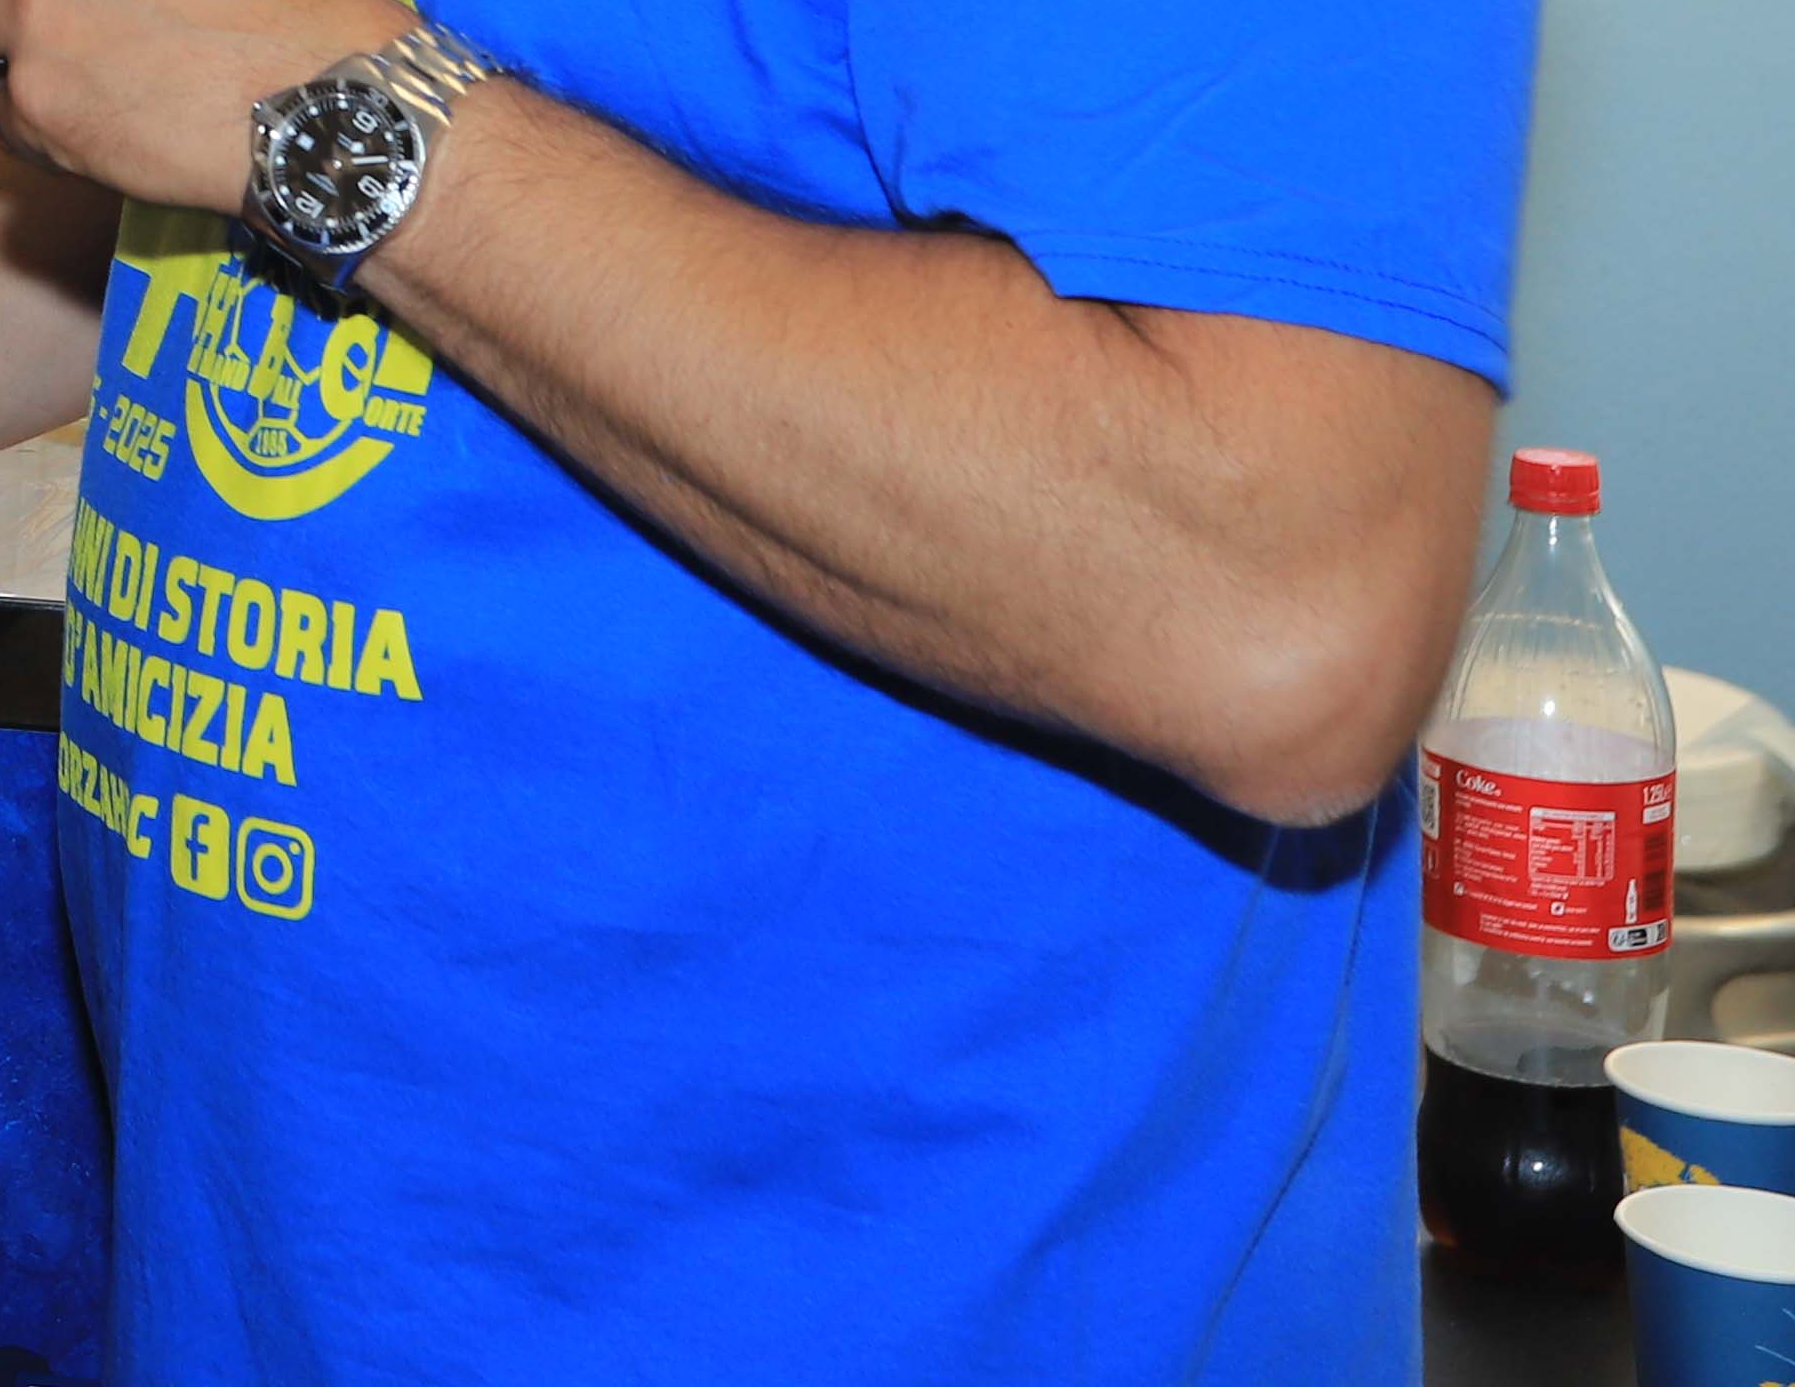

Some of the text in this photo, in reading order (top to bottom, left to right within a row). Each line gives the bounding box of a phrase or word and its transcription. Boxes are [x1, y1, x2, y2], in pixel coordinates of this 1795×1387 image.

[103, 394, 177, 482] 2025
[108, 529, 160, 632] DI
[157, 554, 424, 702] STORIA
